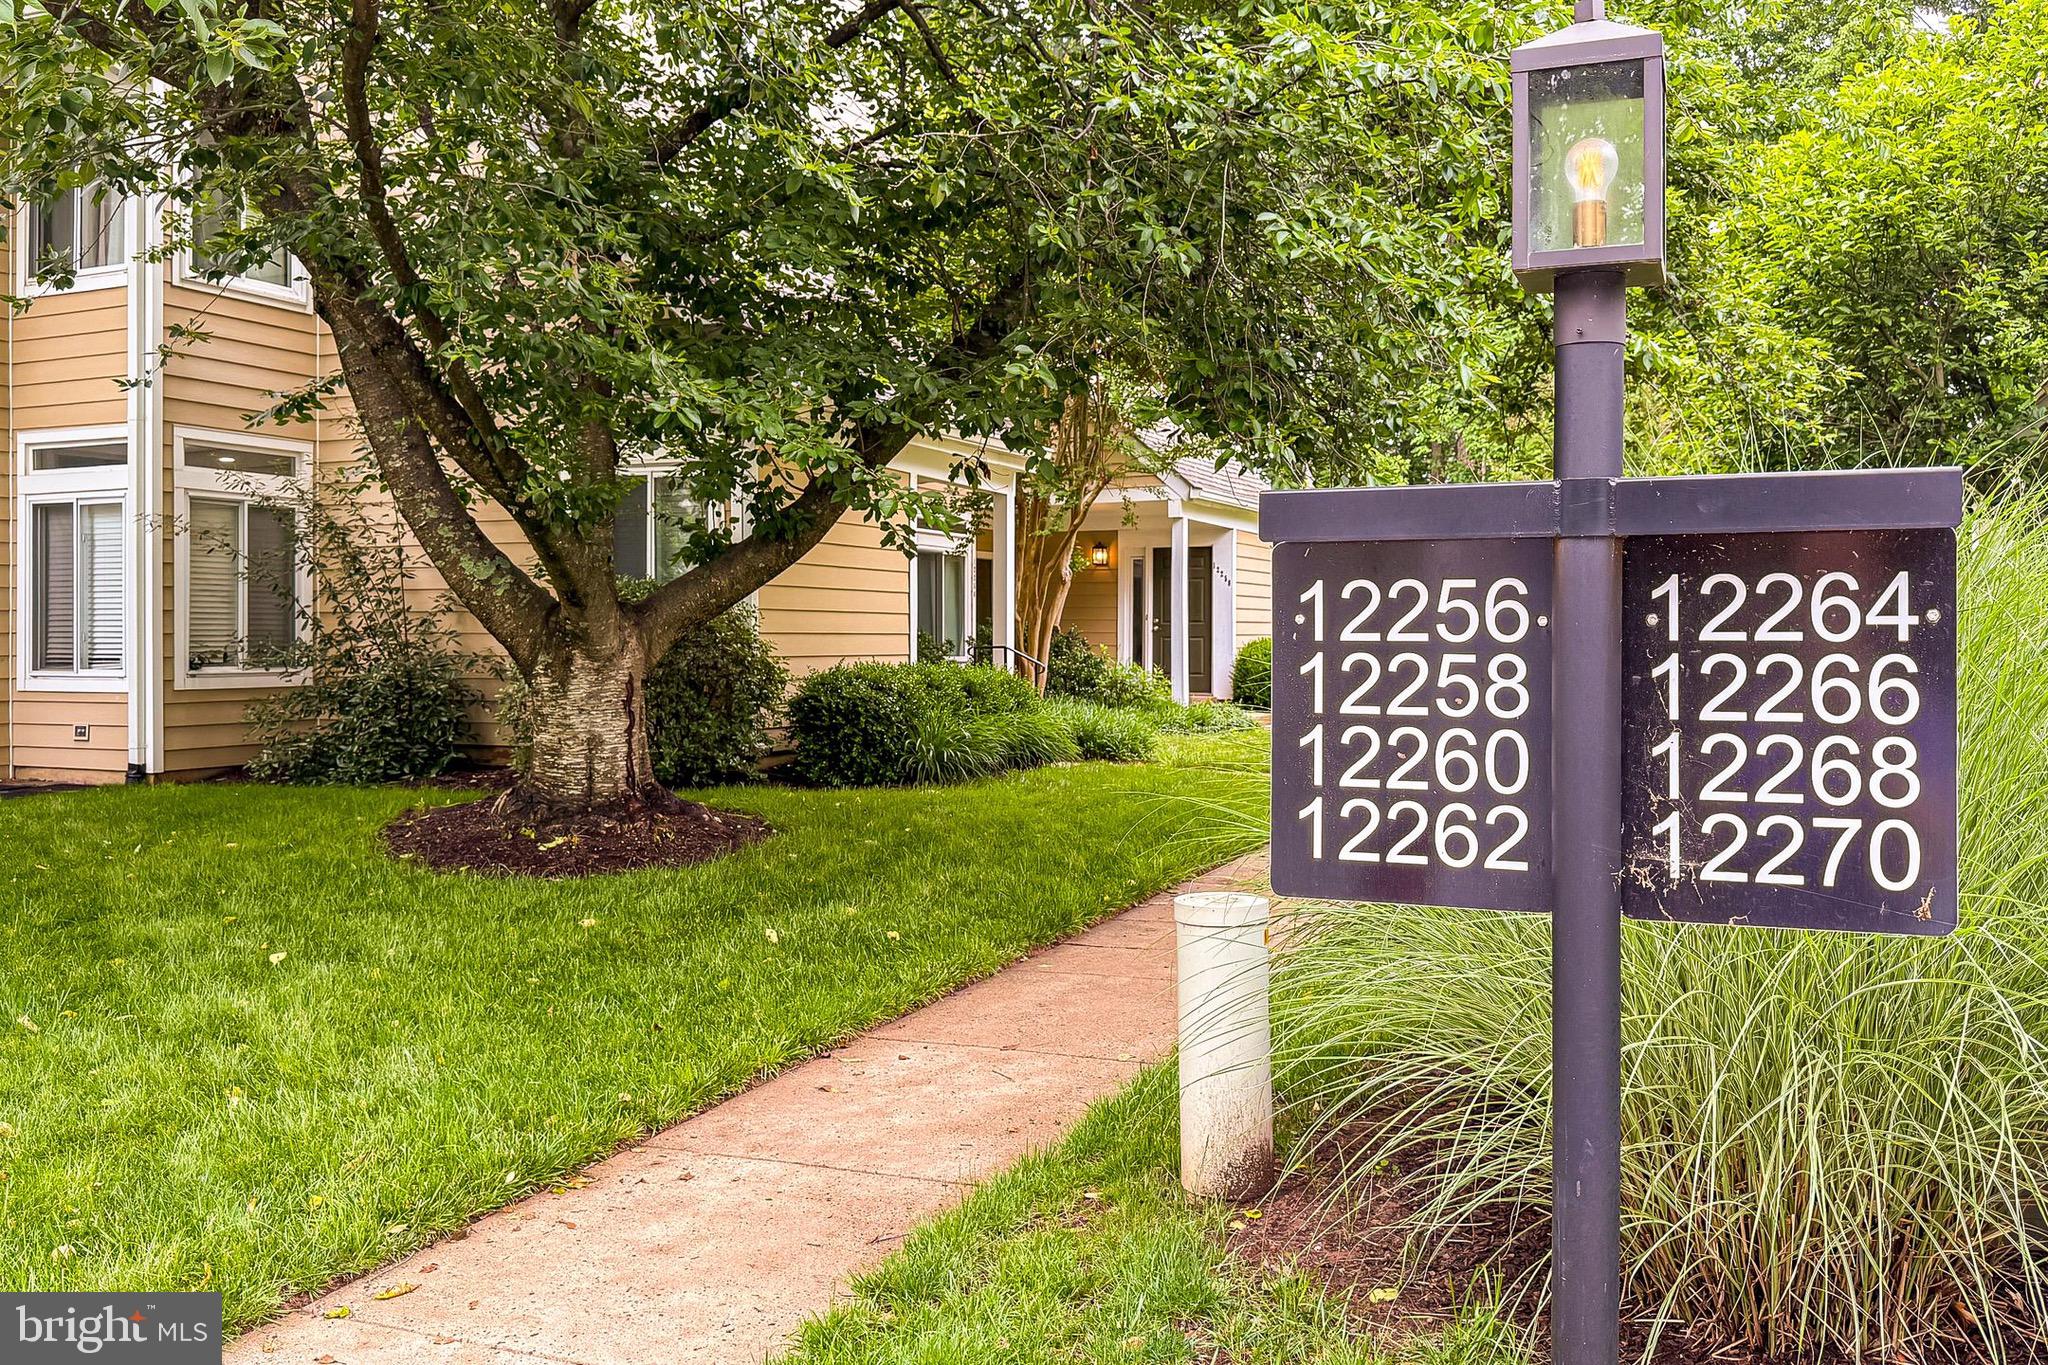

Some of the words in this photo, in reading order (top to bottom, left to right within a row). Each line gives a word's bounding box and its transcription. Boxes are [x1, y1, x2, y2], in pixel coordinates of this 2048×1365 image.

[1300, 577, 1530, 643] 12256
[1651, 571, 1920, 642] 12264
[1300, 651, 1530, 719] 12258
[1651, 653, 1920, 726] 12266
[1299, 724, 1530, 795] 12260
[1651, 731, 1921, 809] 12268
[1298, 796, 1530, 872] 12262
[1651, 810, 1921, 892] 12270
